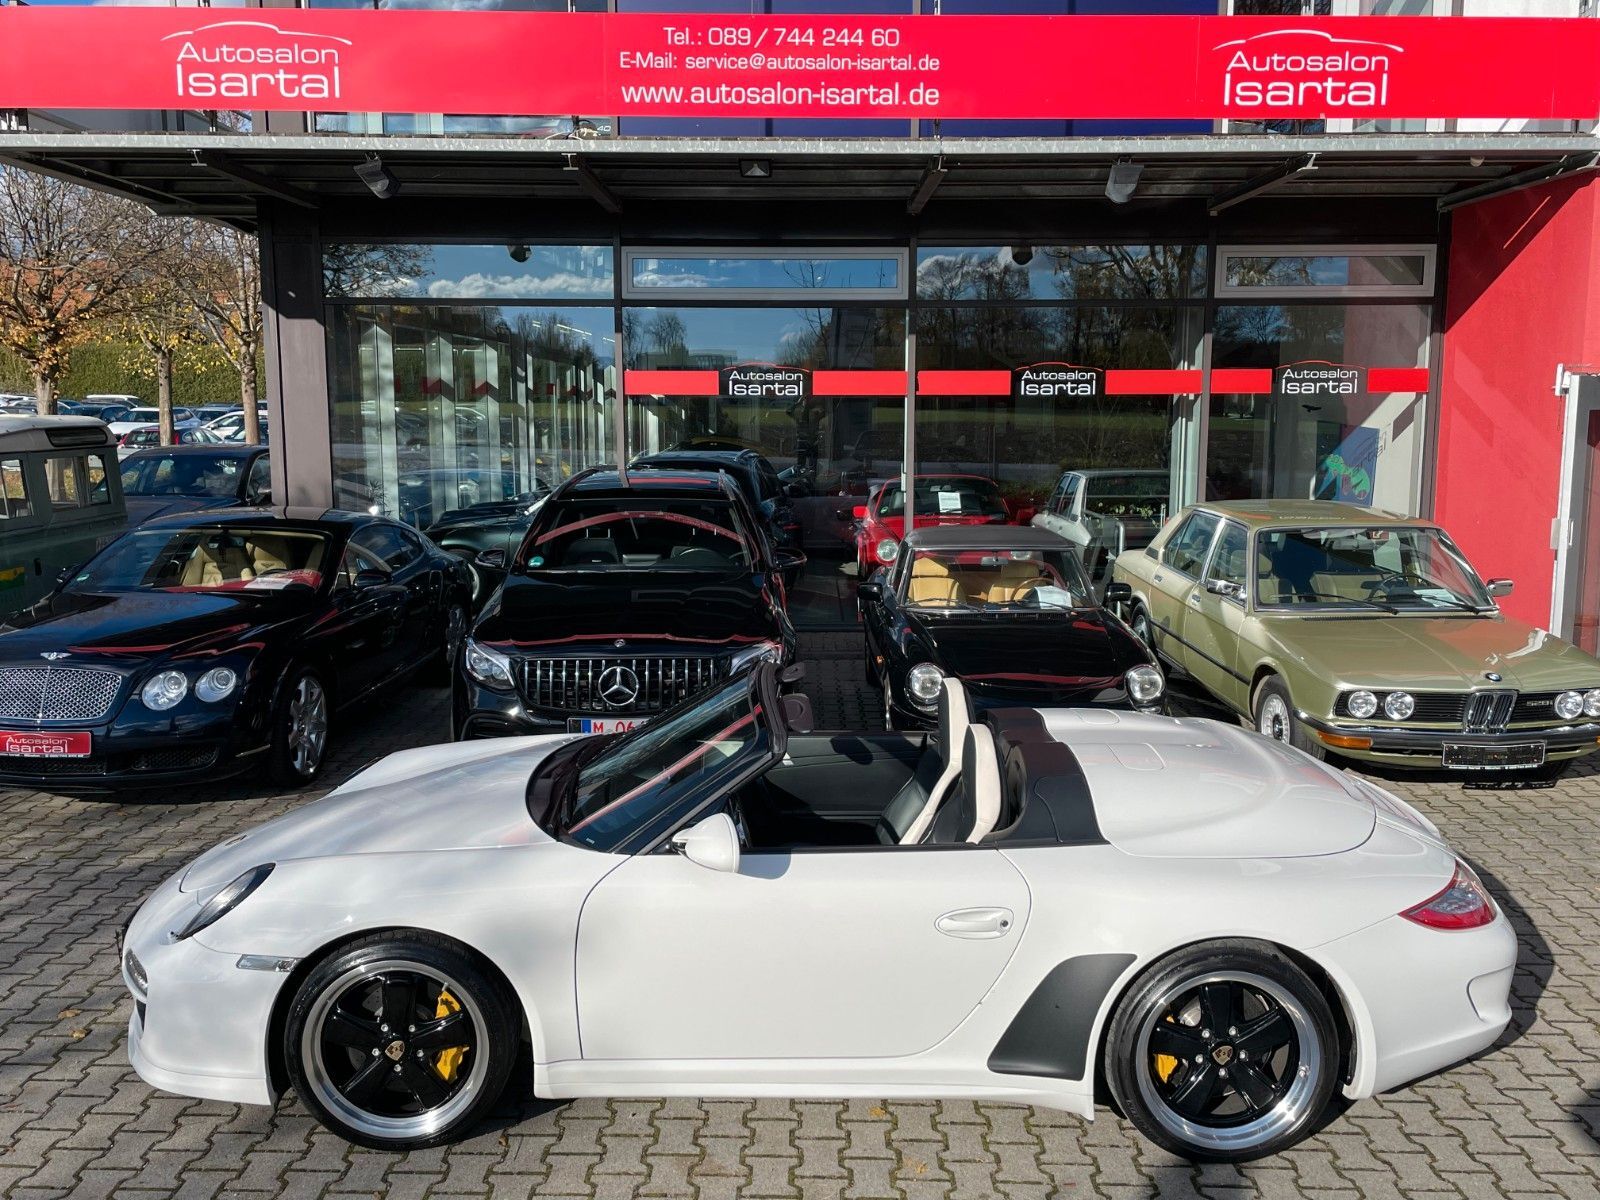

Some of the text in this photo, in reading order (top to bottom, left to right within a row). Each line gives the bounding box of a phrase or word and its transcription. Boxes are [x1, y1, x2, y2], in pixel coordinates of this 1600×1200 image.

[662, 27, 702, 46] Tel.:
[708, 28, 751, 46] 089
[773, 28, 815, 46] 744
[822, 29, 864, 47] 244
[871, 29, 899, 47] 60
[176, 41, 339, 65] Autosalon
[1226, 50, 1389, 72] Autosalon
[619, 52, 940, 71] E-Mail: service@autosalon-isartal.de
[176, 63, 340, 99] Isartal
[621, 81, 940, 106] www.autosalon-isartal.de
[1223, 73, 1388, 106] Isartal
[729, 371, 803, 381] Autosalon
[1021, 370, 1096, 380] Autosalon
[1282, 368, 1358, 378] Autosalon
[729, 380, 803, 396] Isartal
[1021, 380, 1096, 395] Isartal
[1281, 378, 1358, 394] Isartal
[593, 721, 604, 733] M
[6, 741, 68, 753] Isartal
[7, 736, 68, 744] Autosalon
